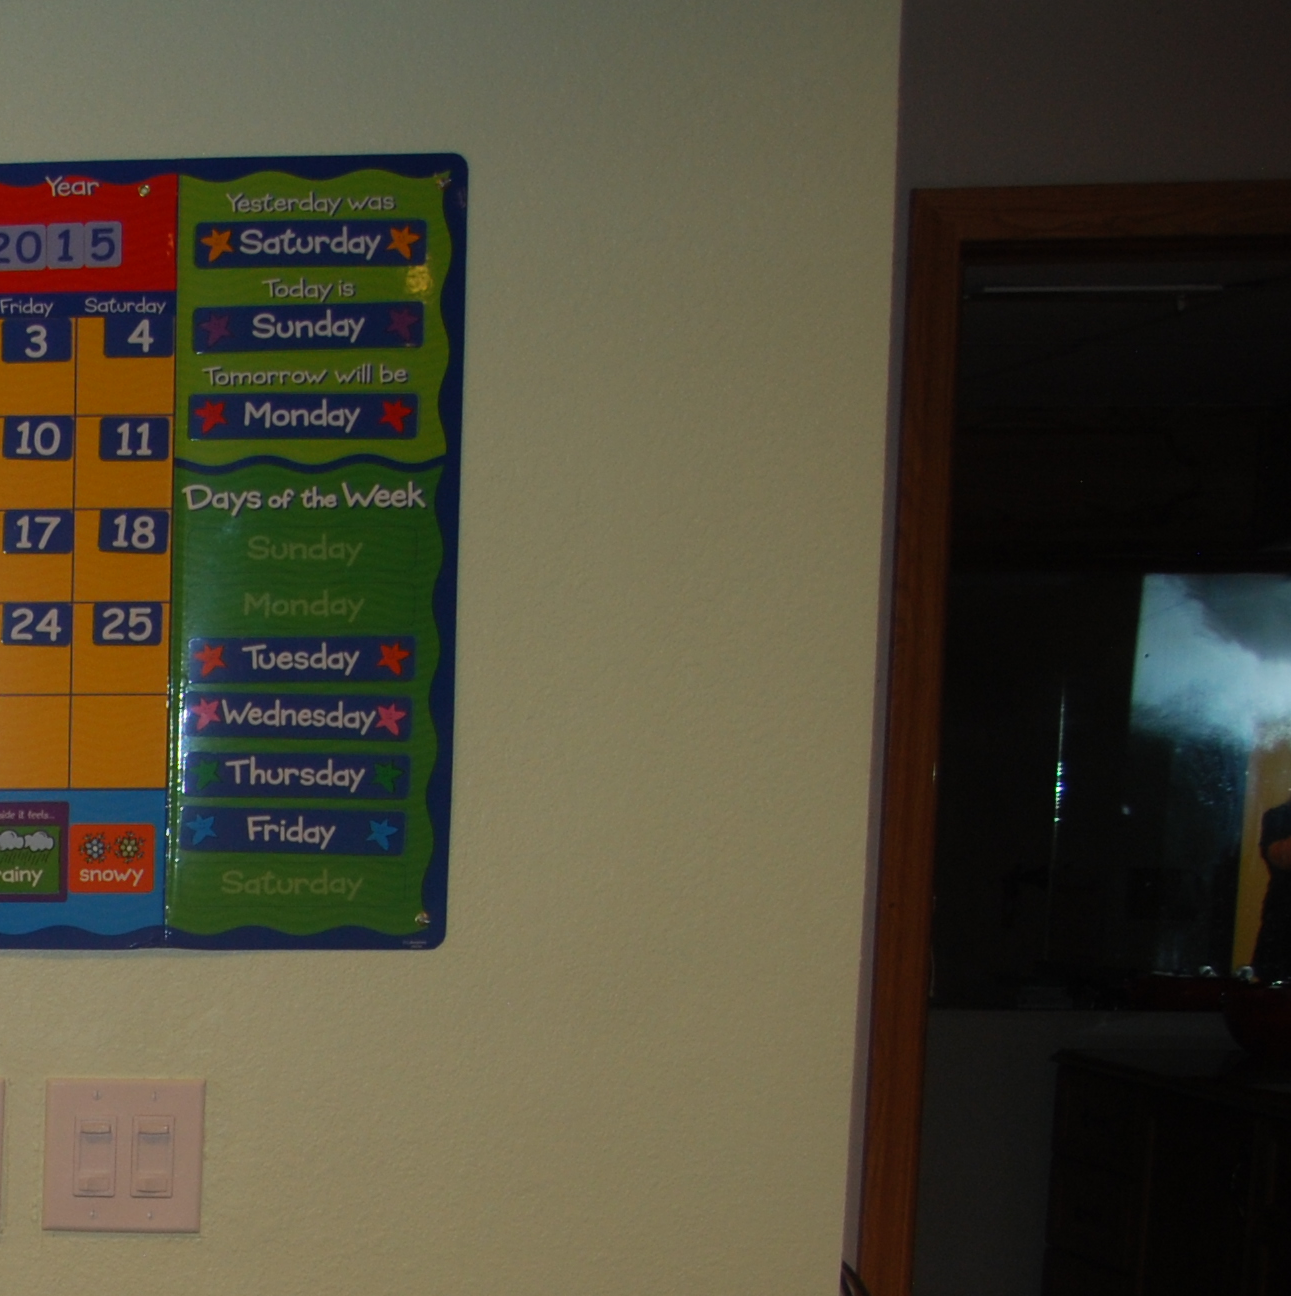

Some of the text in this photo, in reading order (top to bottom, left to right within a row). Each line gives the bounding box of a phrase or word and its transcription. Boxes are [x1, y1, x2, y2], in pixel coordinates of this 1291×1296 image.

[45, 178, 99, 198] Year
[226, 192, 396, 216] Yesterday was
[239, 227, 380, 260] Saturday
[262, 279, 355, 302] Today is
[0, 297, 53, 318] Friday
[85, 296, 165, 316] Saturday
[25, 326, 47, 358] 3
[127, 320, 153, 352] 4
[252, 310, 364, 344] Sunday
[202, 364, 408, 386] Tomorrow will be
[244, 400, 361, 433] Monday
[15, 421, 60, 456] 10
[116, 424, 151, 456] 11
[183, 482, 427, 516] Days of the Week
[16, 516, 60, 549] 17
[113, 516, 155, 549] 18
[247, 535, 363, 566] Sunday
[243, 590, 364, 621] Monday
[11, 608, 61, 640] 24
[102, 608, 152, 640] 25
[241, 643, 359, 674] Tuesday
[221, 699, 375, 735] Wednesday
[225, 756, 365, 792] Thursday
[18, 810, 25, 820] it
[247, 816, 336, 850] Friday
[79, 868, 143, 886] snowy
[221, 871, 363, 898] Saturday
